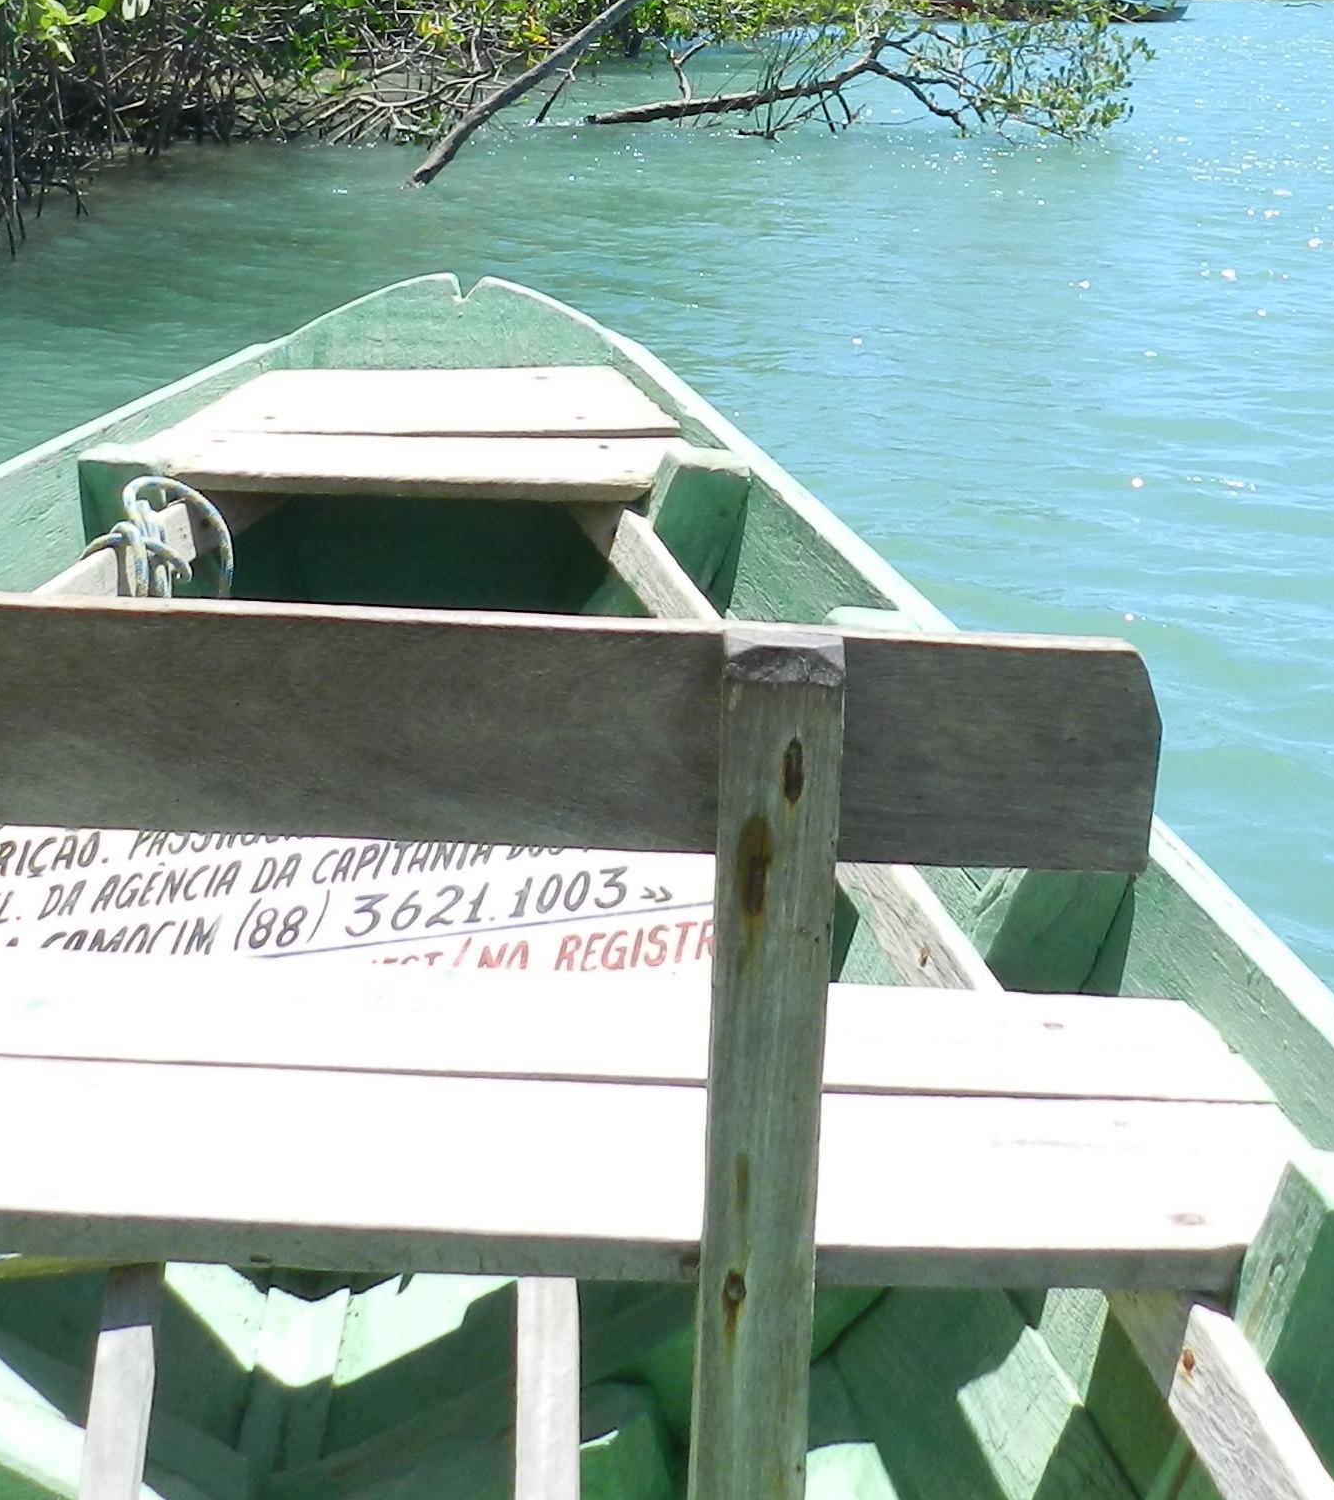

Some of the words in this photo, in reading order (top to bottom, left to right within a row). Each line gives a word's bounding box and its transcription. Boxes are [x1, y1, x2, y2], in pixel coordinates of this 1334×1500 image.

[38, 879, 87, 921] DA
[90, 859, 242, 914] AGÊNCIA
[250, 852, 303, 894] DA
[312, 840, 494, 885] CAPITANIA
[233, 889, 330, 951] (88)
[554, 919, 715, 972] REGISTR
